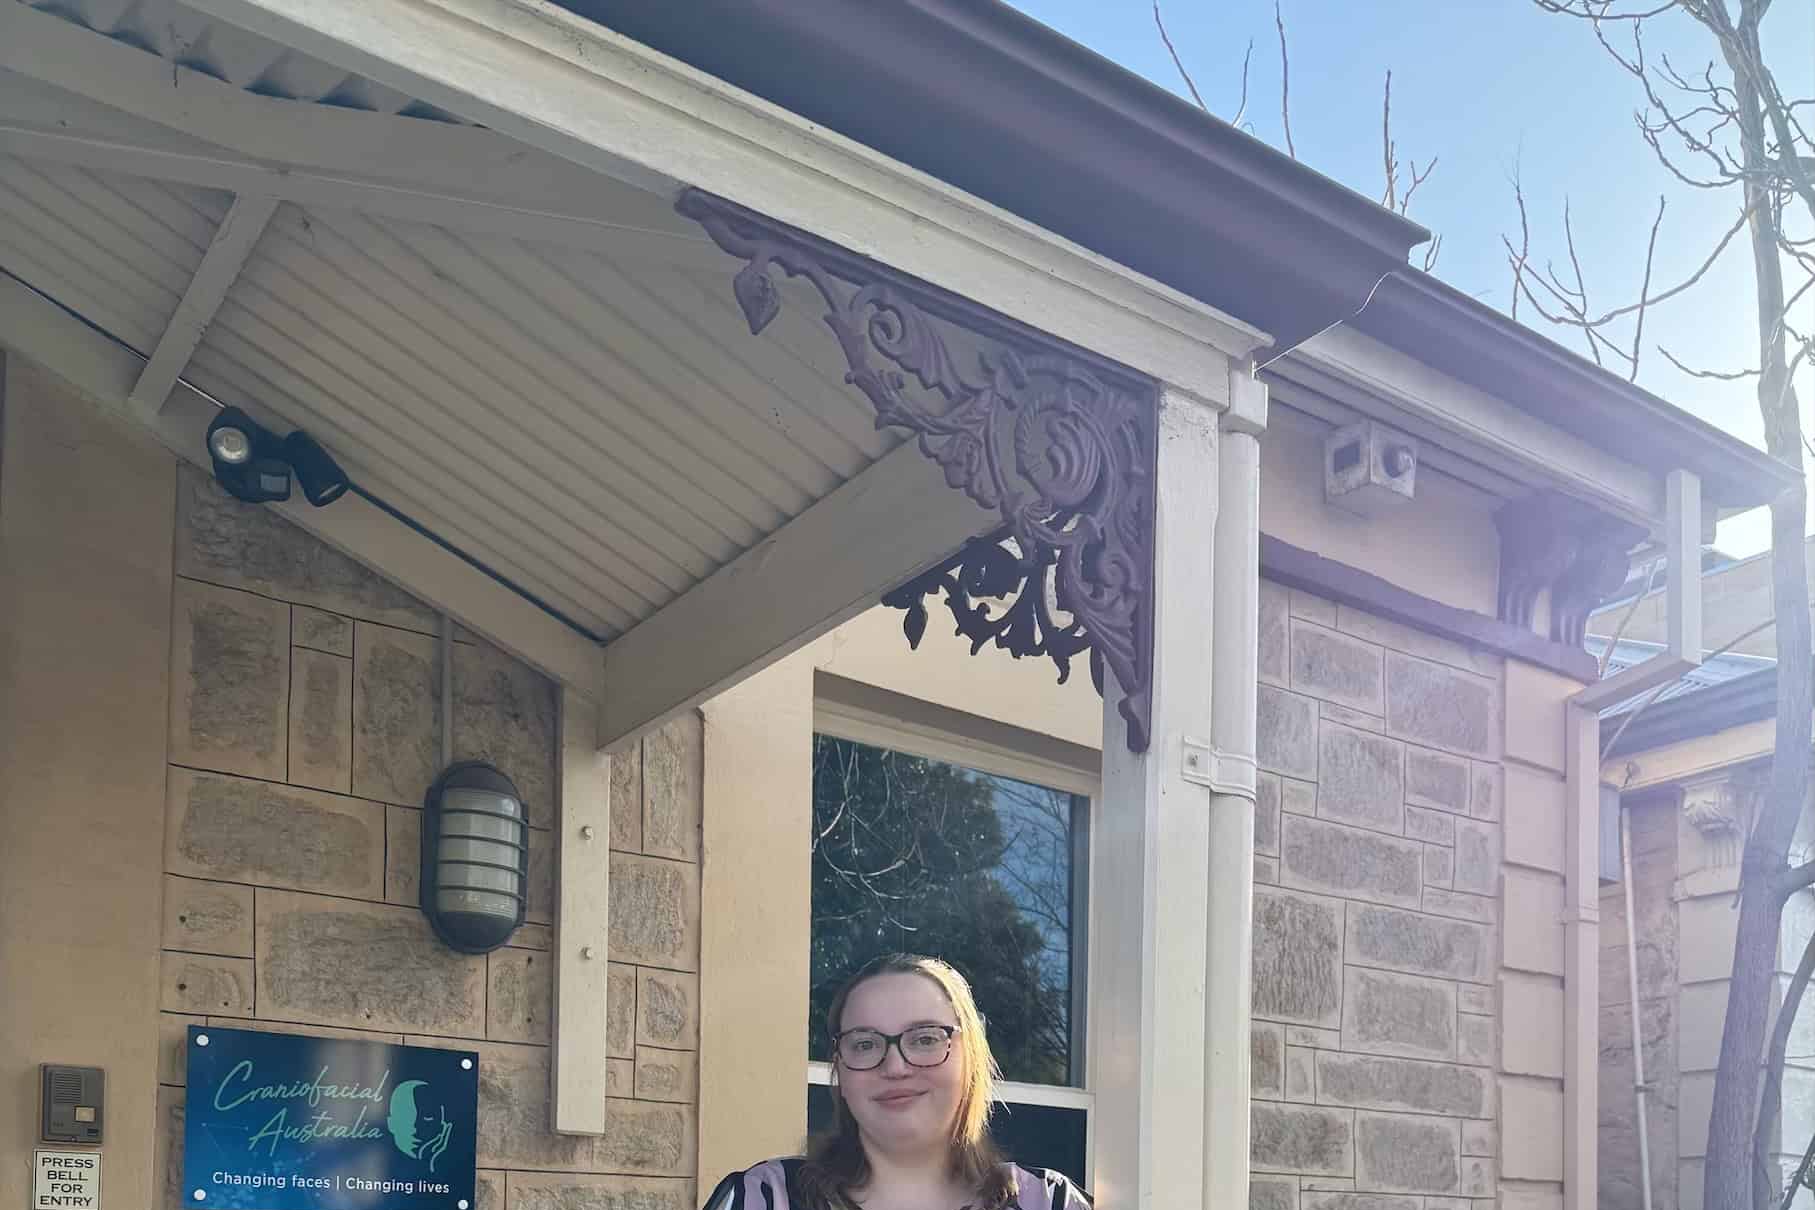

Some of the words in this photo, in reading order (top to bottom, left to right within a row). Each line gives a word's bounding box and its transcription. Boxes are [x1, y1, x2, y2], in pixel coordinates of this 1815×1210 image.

[214, 1060, 389, 1110] Craniofacial
[249, 1106, 384, 1156] Australia
[42, 1157, 94, 1168] PRESS
[47, 1170, 88, 1181] BELL
[212, 1171, 286, 1188] Changing
[292, 1174, 331, 1188] faces
[345, 1177, 413, 1194] Changing
[418, 1181, 450, 1194] lives
[51, 1183, 83, 1194] FOR
[40, 1196, 92, 1206] ENTRY
